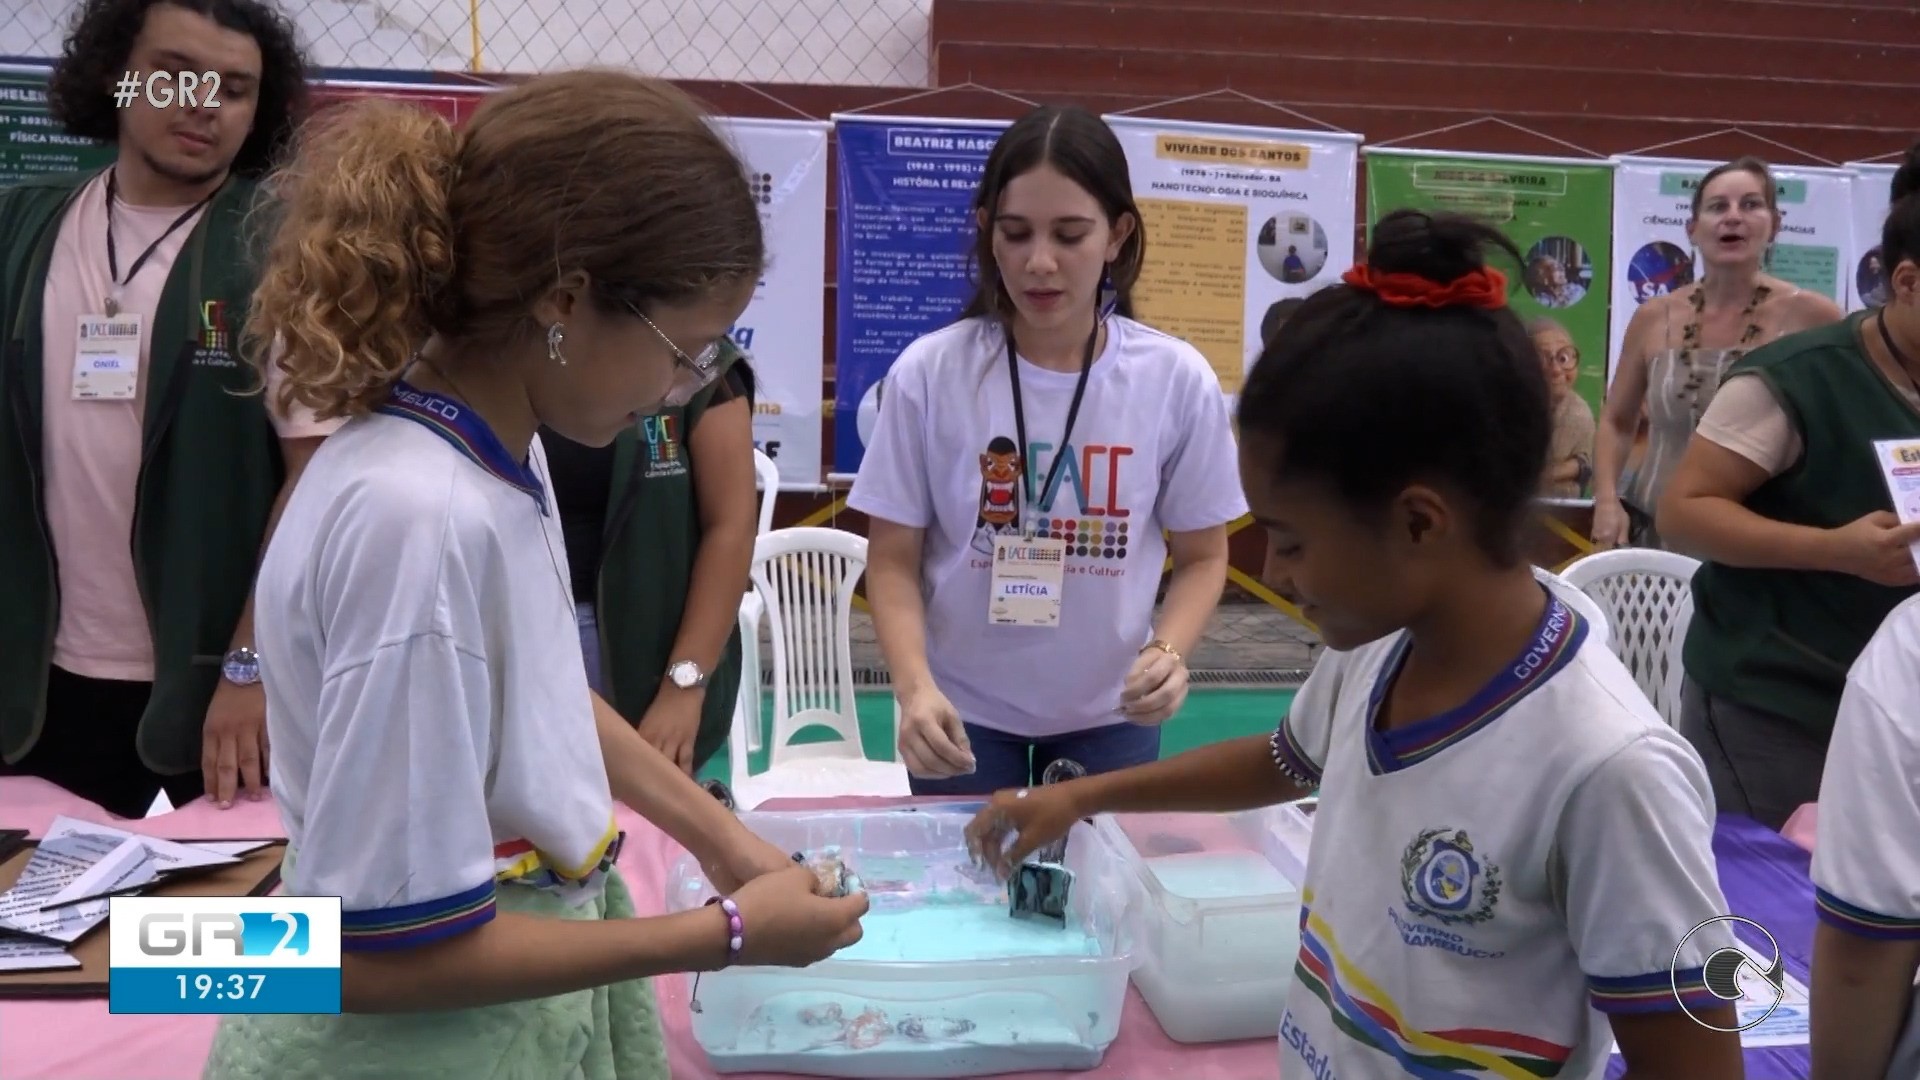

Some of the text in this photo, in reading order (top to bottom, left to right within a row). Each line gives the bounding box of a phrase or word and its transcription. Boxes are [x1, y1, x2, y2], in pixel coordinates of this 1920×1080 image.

[10, 130, 48, 143] FÍSICA
[894, 136, 998, 151] BEATRIZ NASC
[1164, 142, 1302, 162] VIVIANE DOS SANTOS
[893, 176, 940, 189] HISTÓRIA
[951, 180, 982, 190] RELA
[1151, 182, 1241, 197] NANOTECNOLOGIA
[1252, 188, 1309, 201] BIOQUÍMICA
[1005, 583, 1049, 596] LETÍCIA
[1513, 600, 1567, 680] GOVERN
